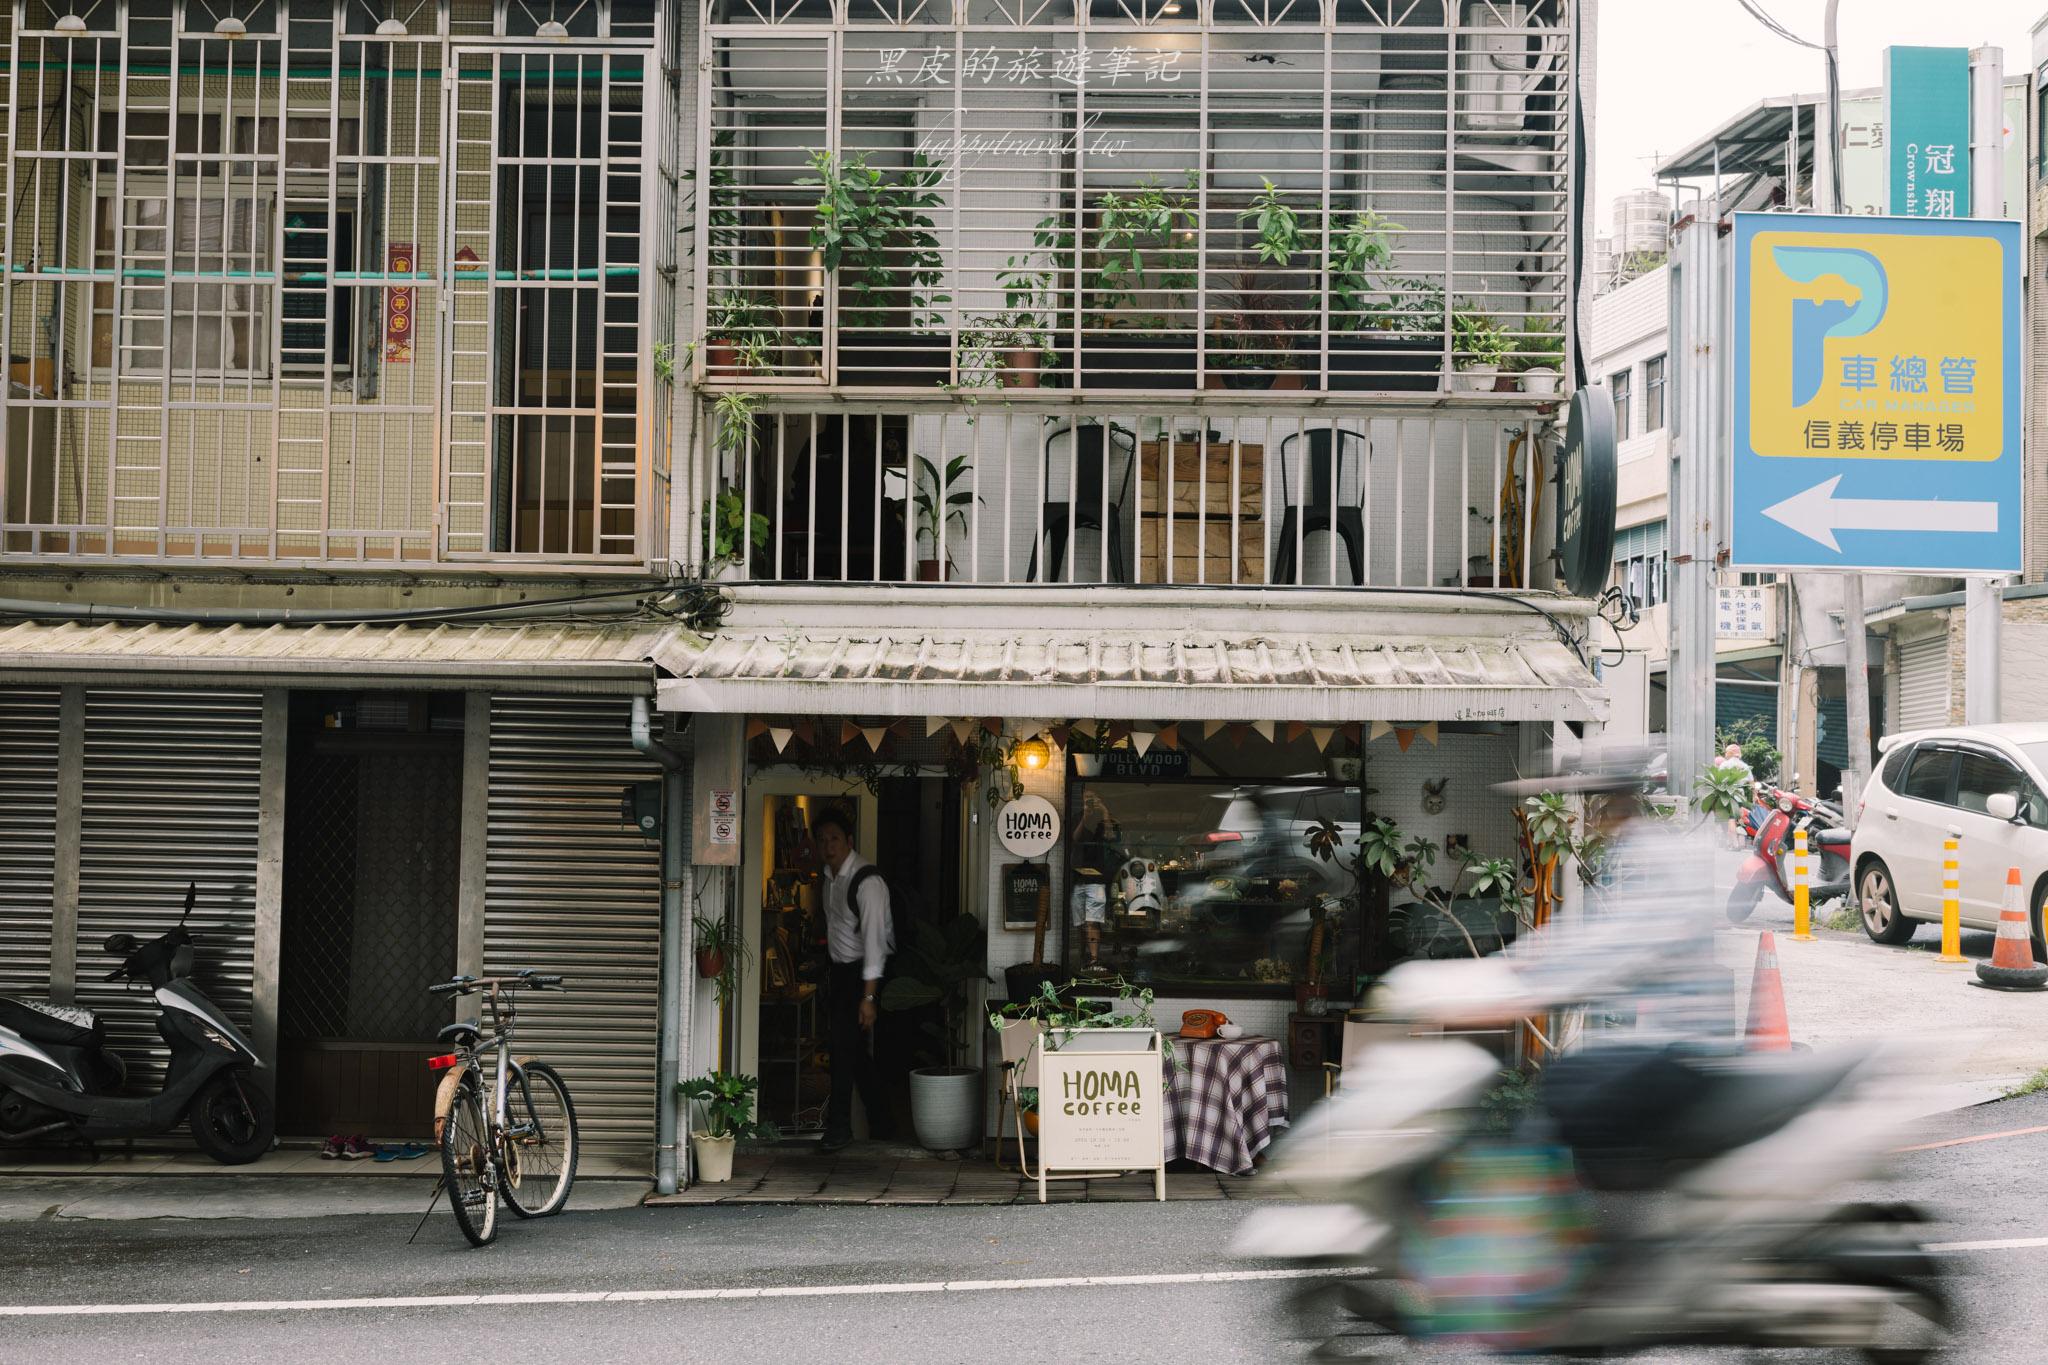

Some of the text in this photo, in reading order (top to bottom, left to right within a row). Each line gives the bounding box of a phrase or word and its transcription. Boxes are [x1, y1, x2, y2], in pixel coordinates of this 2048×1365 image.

[1906, 143, 1919, 217] Crownshi
[1924, 144, 1955, 218] 冠翔
[392, 259, 408, 329] 富平安
[1840, 354, 1977, 395] 車總管
[1840, 399, 1976, 414] CAR MANAGER
[1803, 419, 1965, 453] 信義停車場
[1116, 763, 1161, 776] BLVD
[1006, 812, 1052, 831] HOMA
[1013, 878, 1039, 888] HOMA
[1063, 1070, 1140, 1101] HOMA
